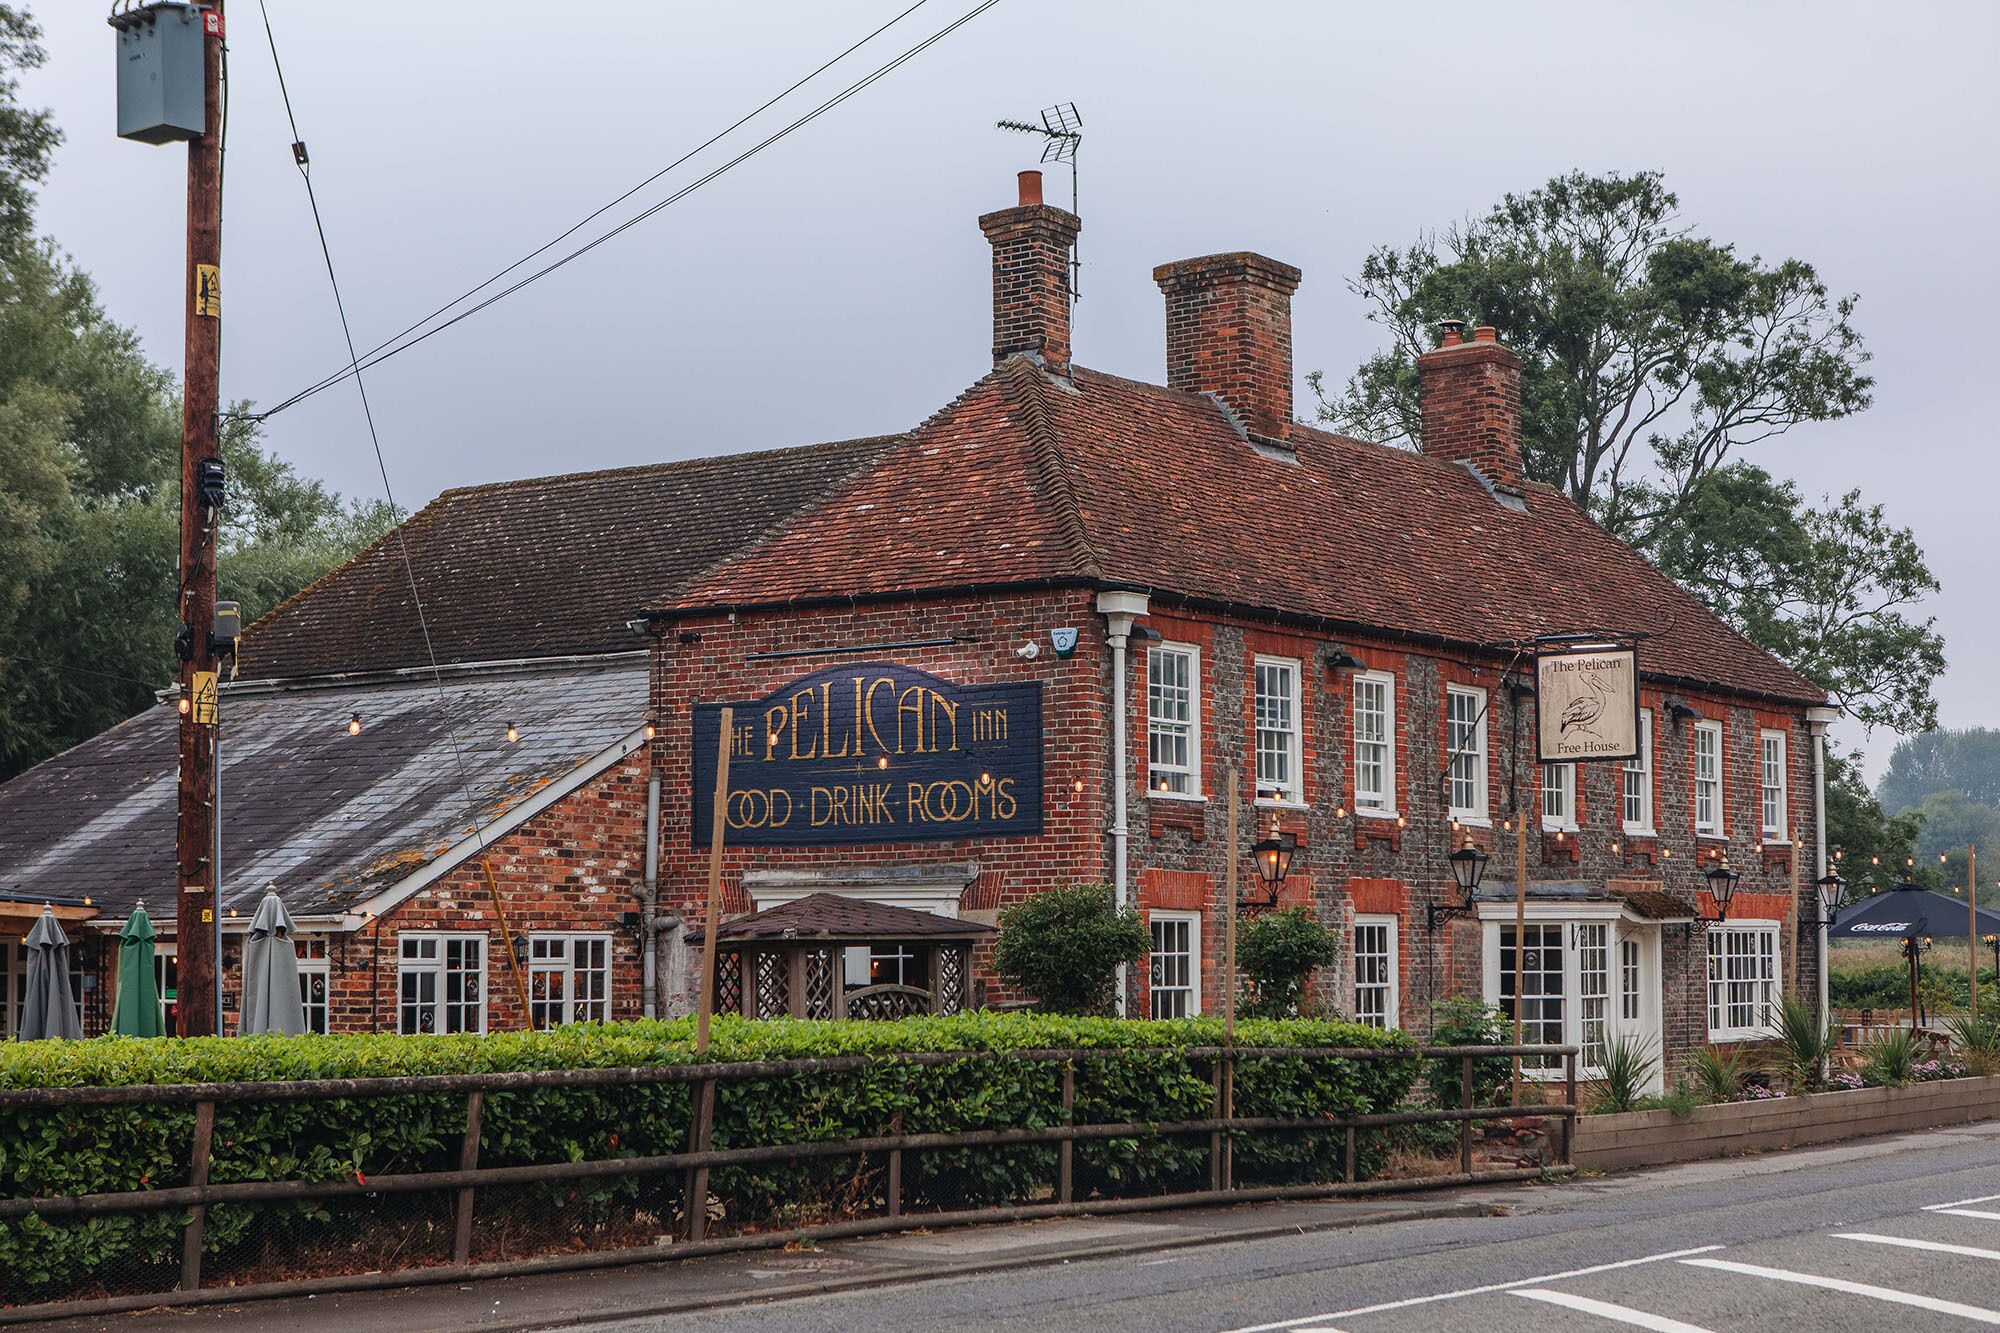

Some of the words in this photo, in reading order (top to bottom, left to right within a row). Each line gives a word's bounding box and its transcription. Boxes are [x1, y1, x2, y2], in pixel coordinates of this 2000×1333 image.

[1552, 660, 1574, 672] The
[1577, 658, 1620, 670] Pelican
[731, 726, 753, 756] HE
[763, 676, 960, 761] PELICAN
[972, 708, 1008, 742] INN
[1557, 742, 1581, 753] Free
[1584, 740, 1620, 753] House
[725, 788, 792, 829] OOD
[811, 783, 895, 826] DRINK
[908, 777, 1017, 823] ROOMS
